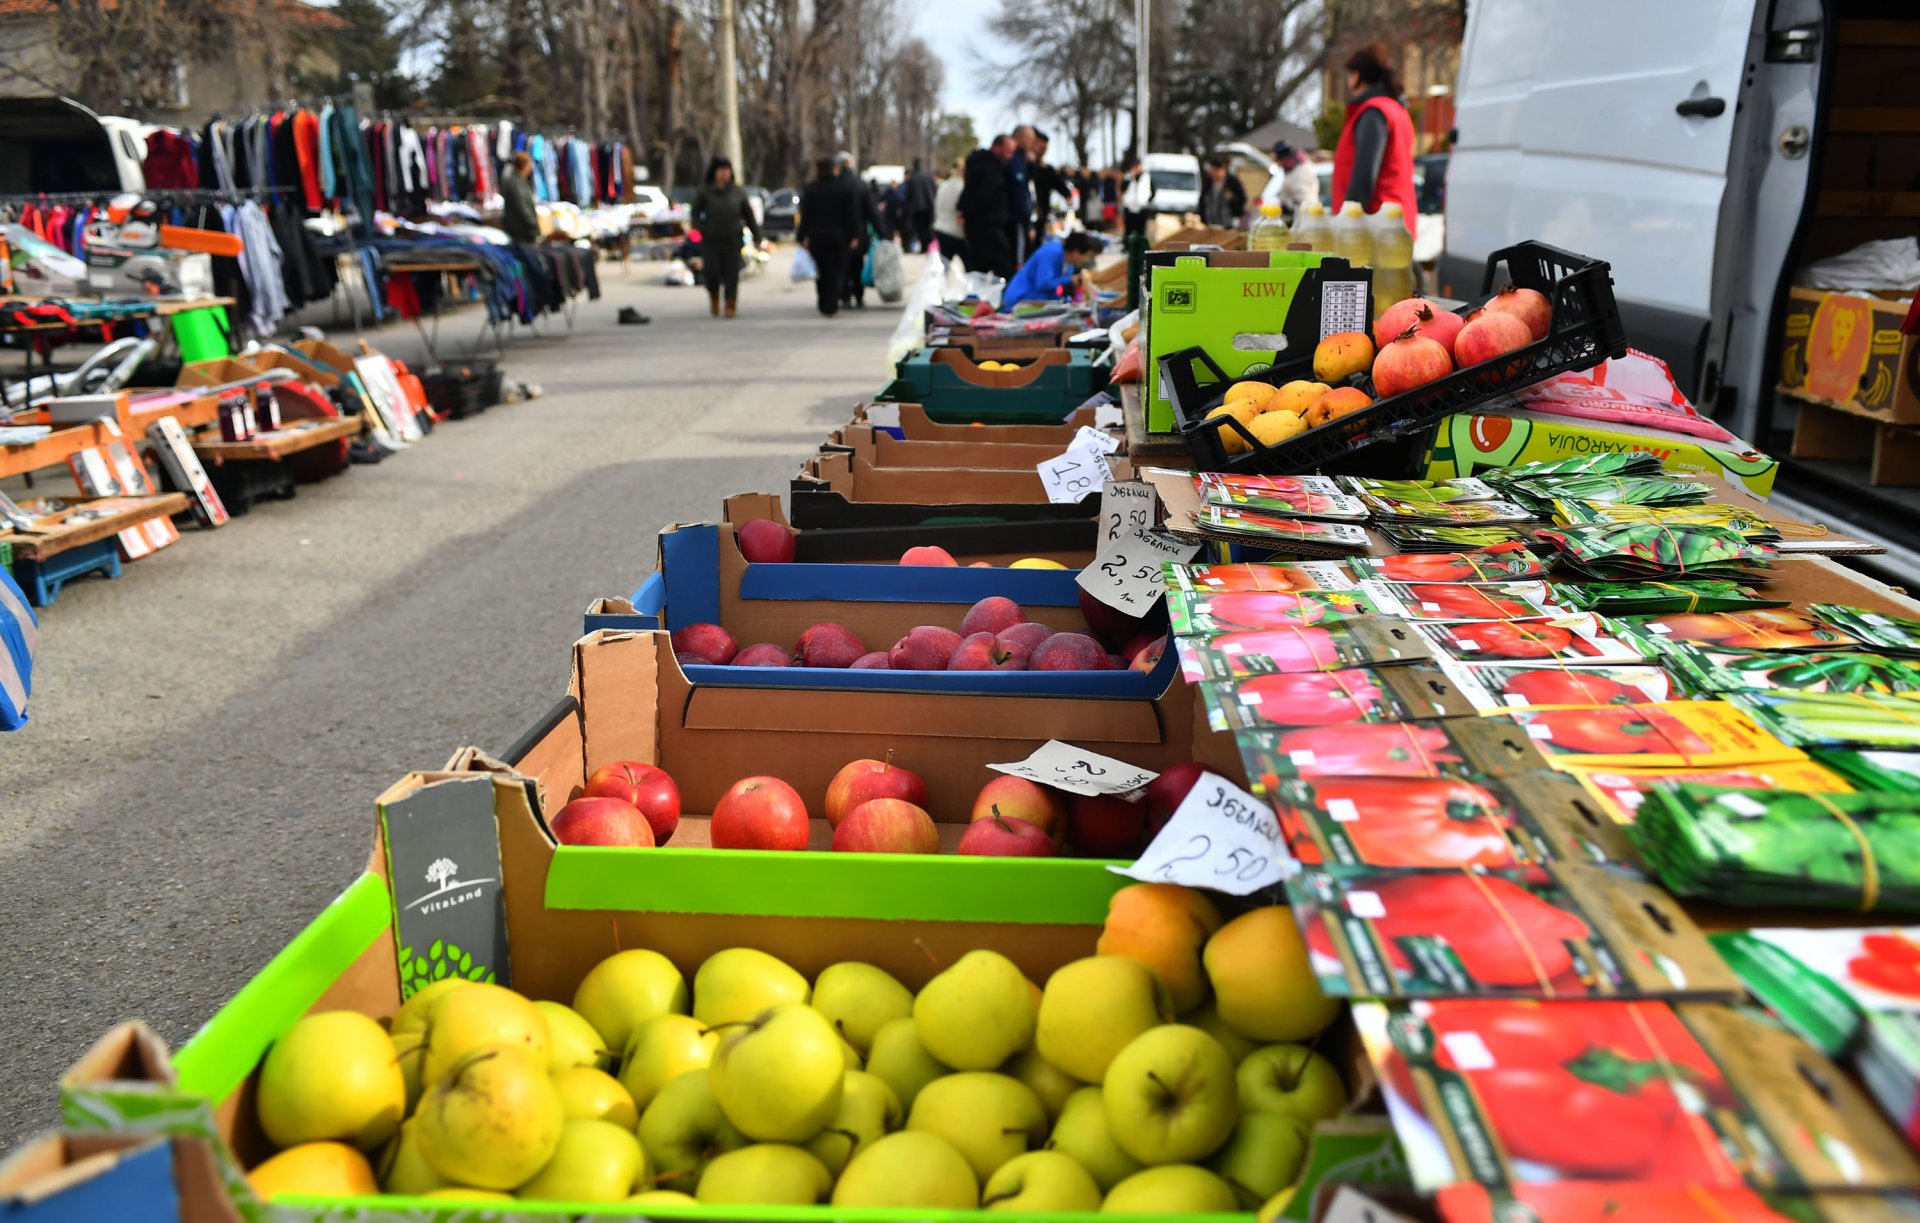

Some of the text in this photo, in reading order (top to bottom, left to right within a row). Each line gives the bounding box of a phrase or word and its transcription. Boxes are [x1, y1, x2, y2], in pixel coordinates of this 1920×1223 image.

[1242, 282, 1286, 297] KIWI
[1214, 847, 1268, 882] 50
[420, 887, 483, 915] VitaLand
